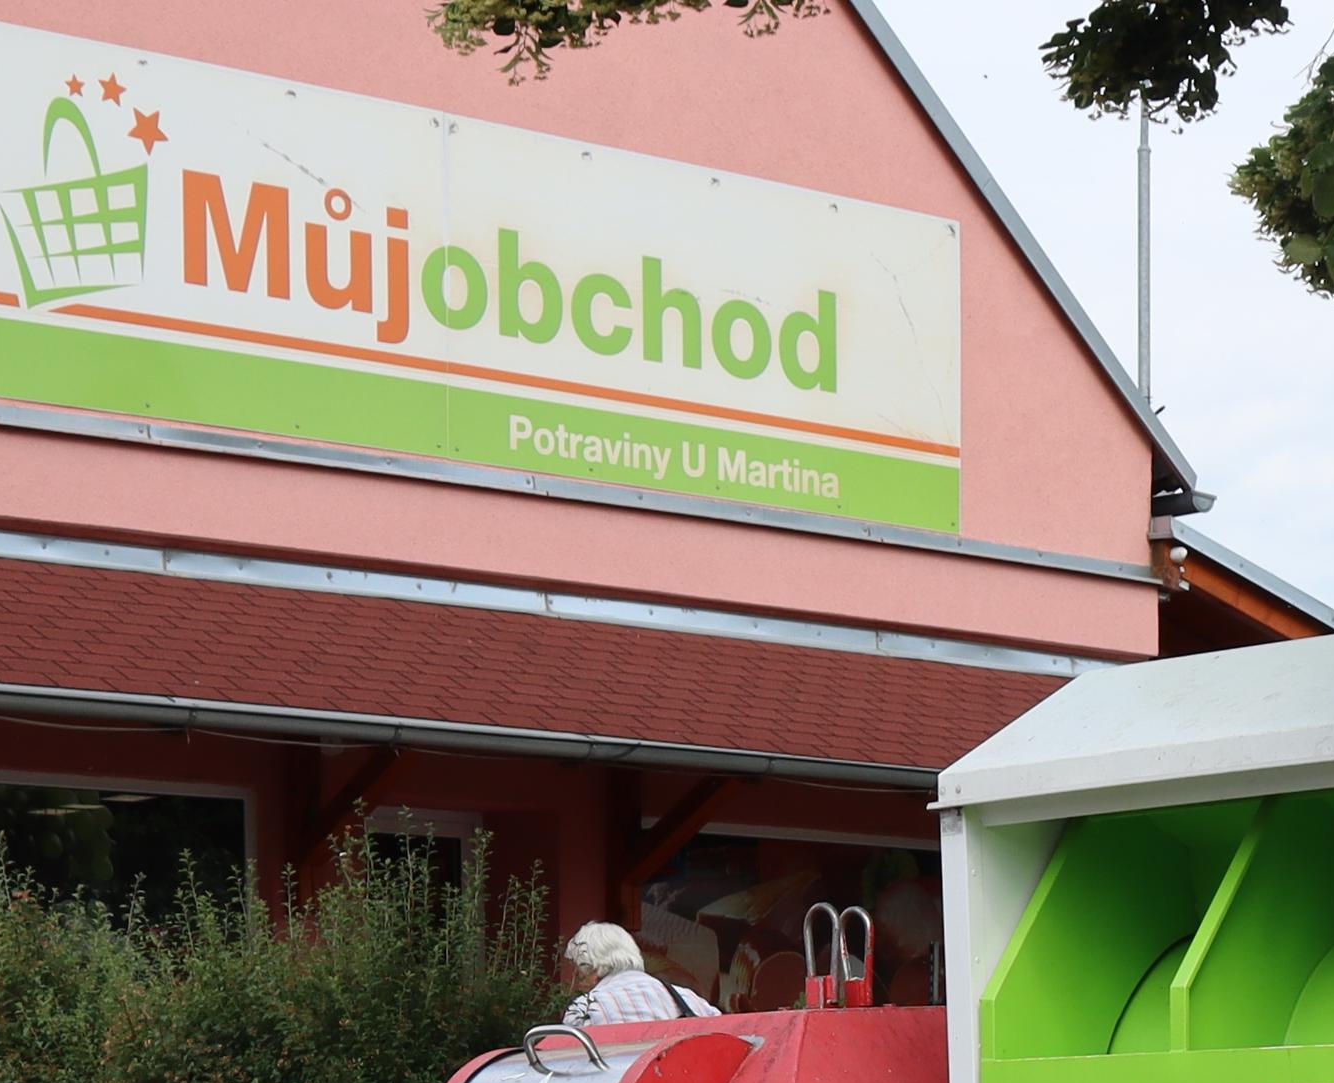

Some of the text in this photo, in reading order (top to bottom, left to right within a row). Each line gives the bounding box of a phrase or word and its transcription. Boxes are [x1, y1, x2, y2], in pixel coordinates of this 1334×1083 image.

[509, 415, 840, 500] Potraviny U Martina
